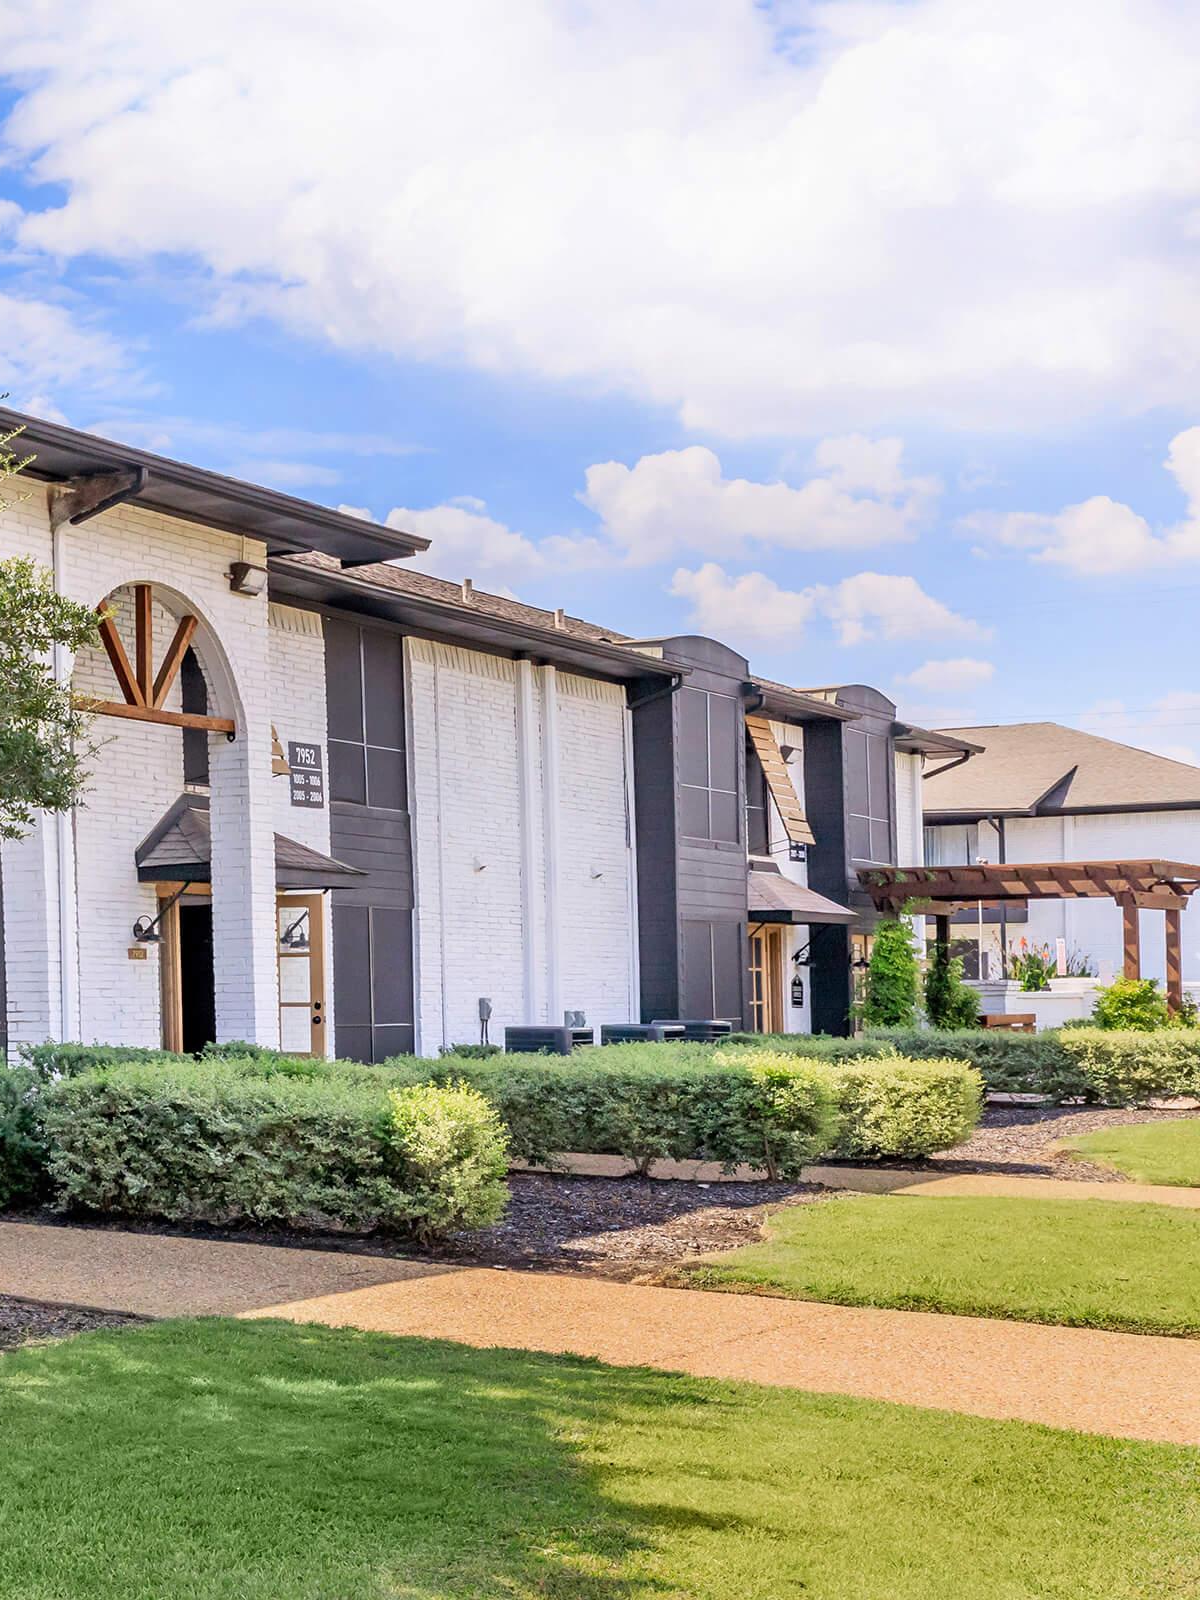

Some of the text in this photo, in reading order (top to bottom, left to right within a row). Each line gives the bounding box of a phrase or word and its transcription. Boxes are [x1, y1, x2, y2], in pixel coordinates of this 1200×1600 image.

[295, 747, 316, 765] 7952
[293, 773, 305, 785] 1005
[309, 775, 321, 787] 1006
[293, 789, 305, 801] 2005
[310, 791, 322, 802] 2006
